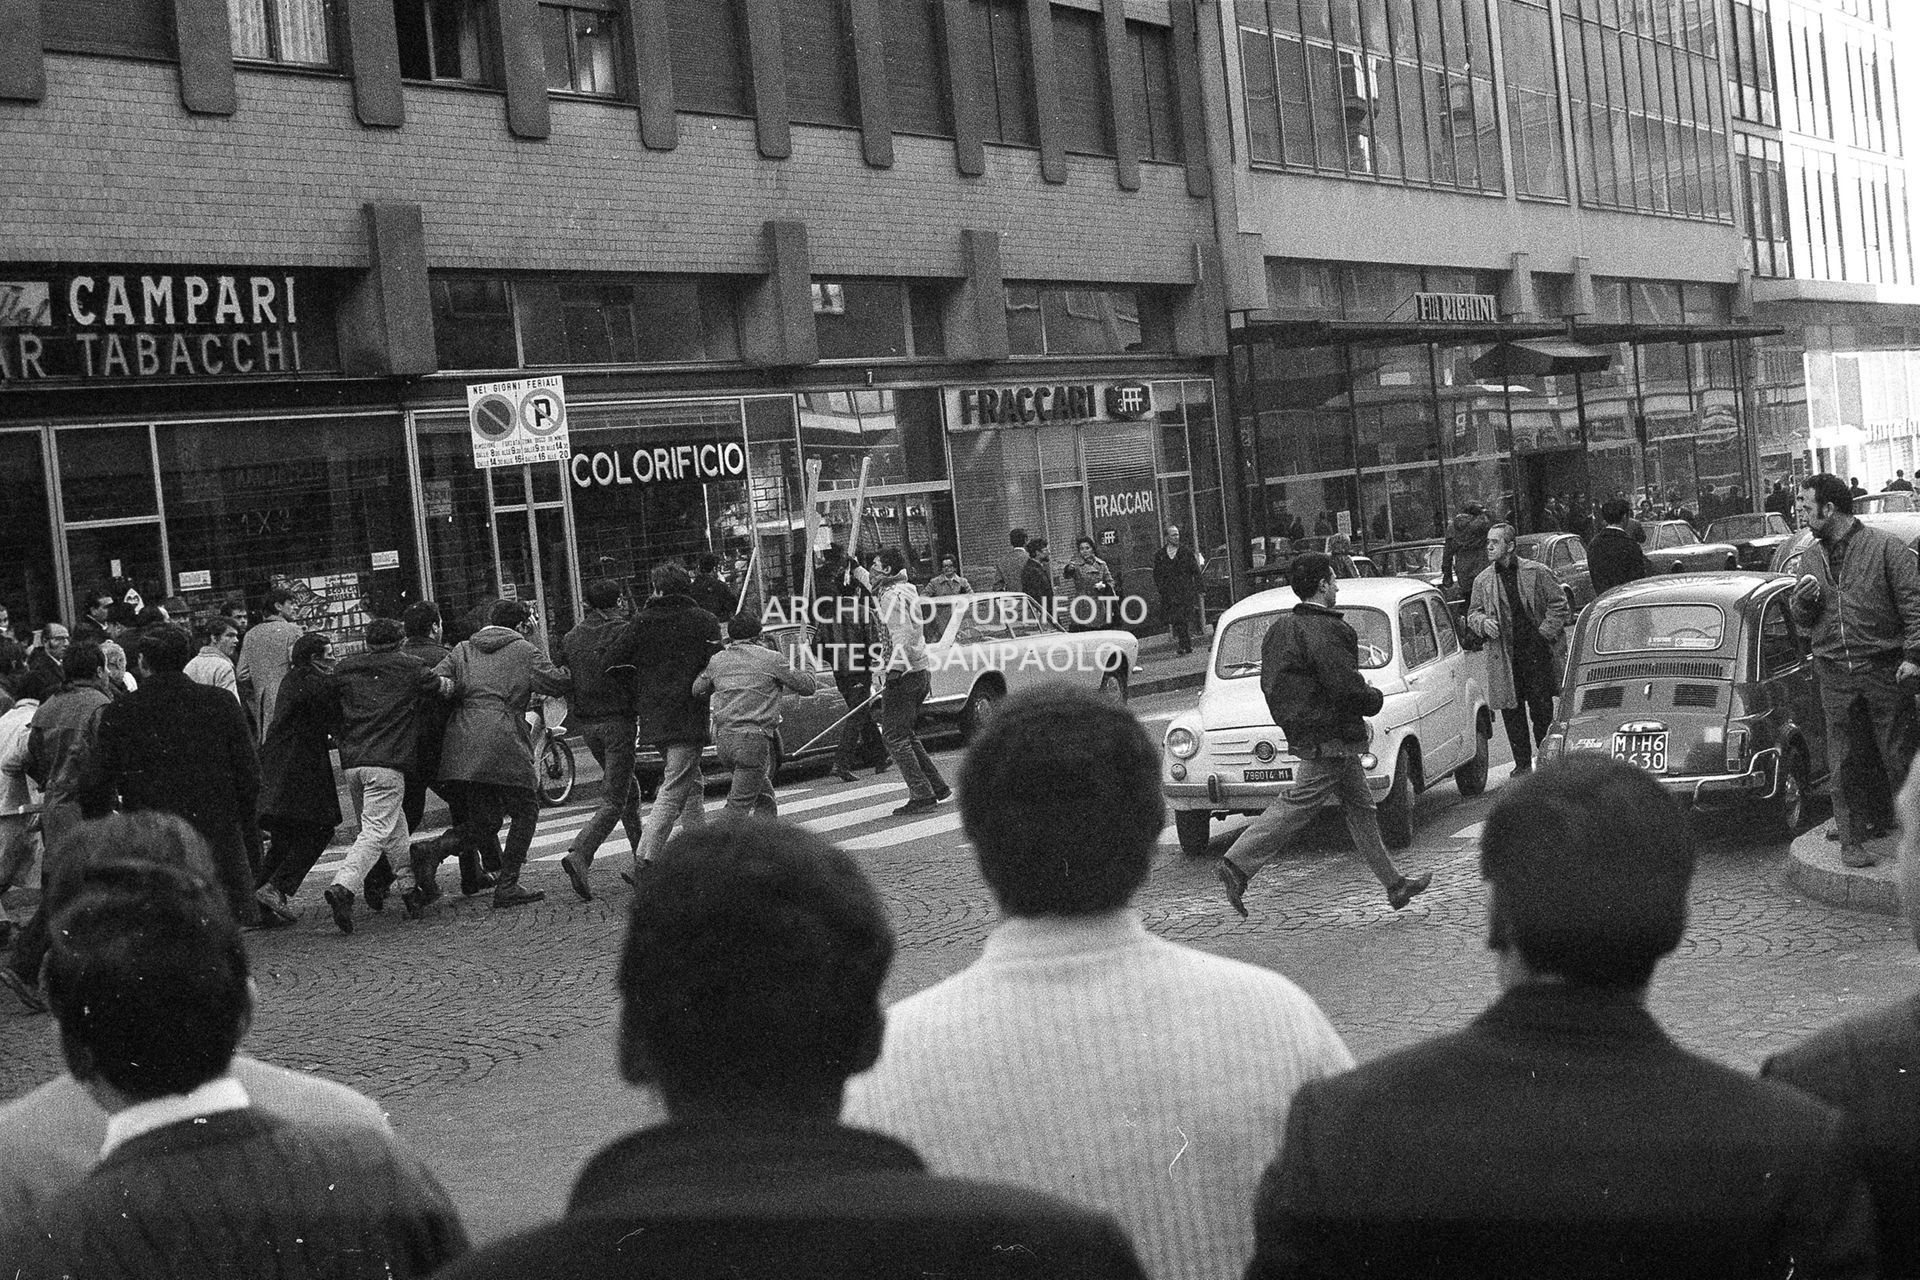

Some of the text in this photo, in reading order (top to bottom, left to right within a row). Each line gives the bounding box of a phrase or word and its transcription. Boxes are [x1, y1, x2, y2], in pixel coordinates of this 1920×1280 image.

[70, 275, 297, 325] CAMPARI
[76, 331, 300, 377] TABACCHI
[473, 378, 559, 394] NEI GIORNI FERIALI
[959, 384, 1097, 425] FRACCARI
[571, 442, 744, 488] COLORIFICIO
[1093, 489, 1154, 518] FRACCARI
